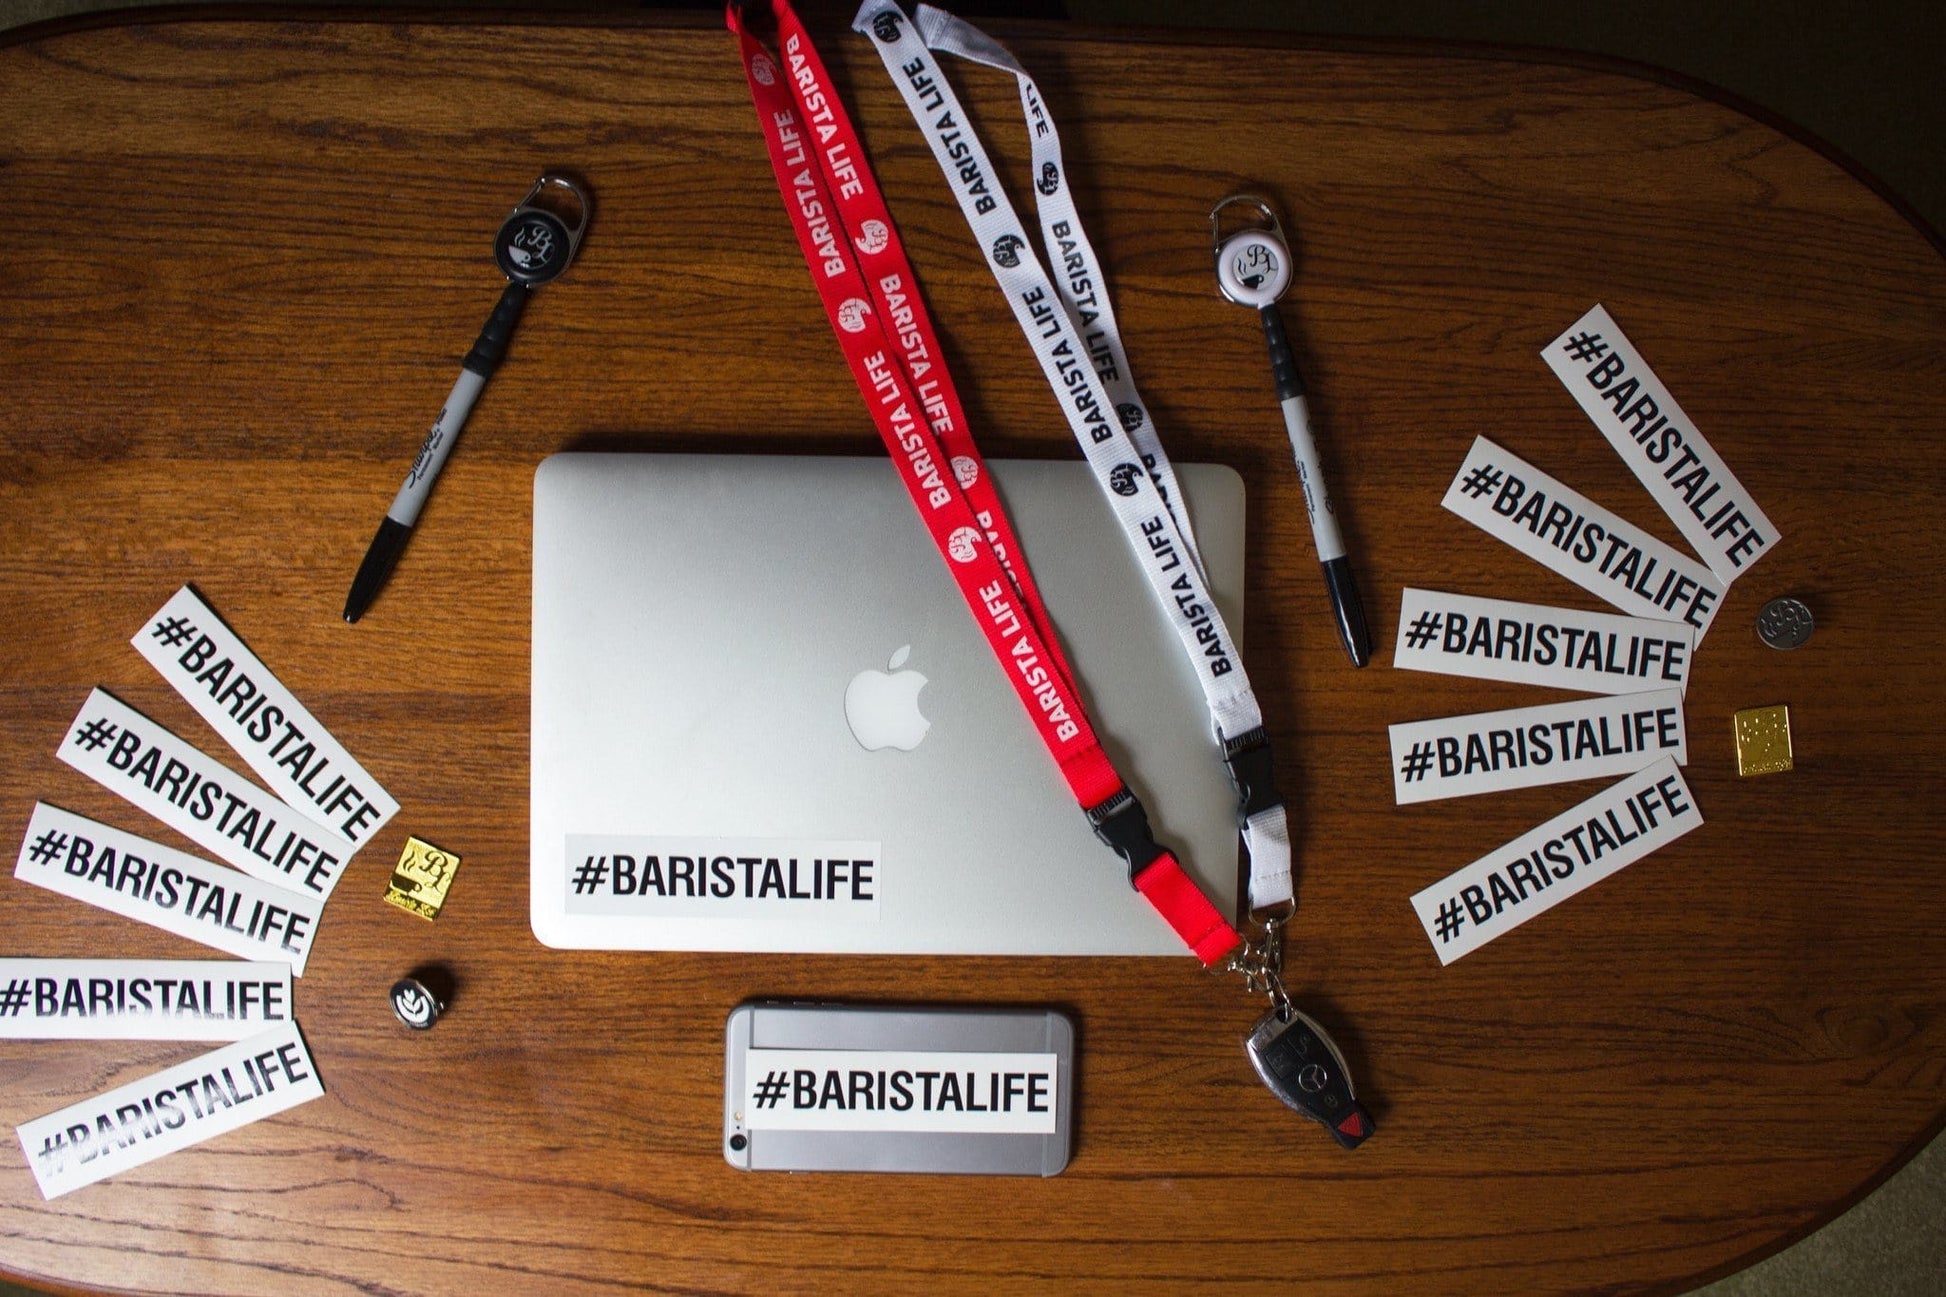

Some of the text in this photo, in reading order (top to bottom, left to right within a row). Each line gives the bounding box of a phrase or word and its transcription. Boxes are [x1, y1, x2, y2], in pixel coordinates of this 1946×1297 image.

[773, 108, 846, 278] BARISTA LIFE
[786, 33, 864, 200] BARISTA LIFE
[902, 57, 997, 217] BARISTA LIFE
[879, 273, 954, 435] BARISTA LIFE
[1022, 286, 1113, 446] BARISTA LIFE
[1052, 220, 1119, 385] BARISTA LIFE
[863, 351, 952, 510] BARISTA LIFE
[1562, 330, 1765, 567] #BARISTALIFE
[979, 579, 1022, 638] LIFE
[1140, 515, 1181, 572] LIFE
[1462, 463, 1717, 630] #BARISTALIFE
[1011, 635, 1080, 743] BARISTA
[1171, 572, 1233, 679] BARISTA
[1405, 610, 1686, 682] #BARISTALIFE
[74, 717, 339, 893] #BARISTALIFE
[151, 615, 382, 842] #BARISTALIFE
[1400, 707, 1679, 783] #BARISTALIFE
[28, 829, 311, 955] #BARISTALIFE
[571, 855, 874, 901] #BARISTALIFE
[1433, 774, 1690, 944] #BARISTALIFE
[0, 978, 284, 1020] #BARISTALIFE
[38, 1042, 309, 1177] #BARISTALIFE
[752, 1069, 1050, 1113] #BARISTALIFE
